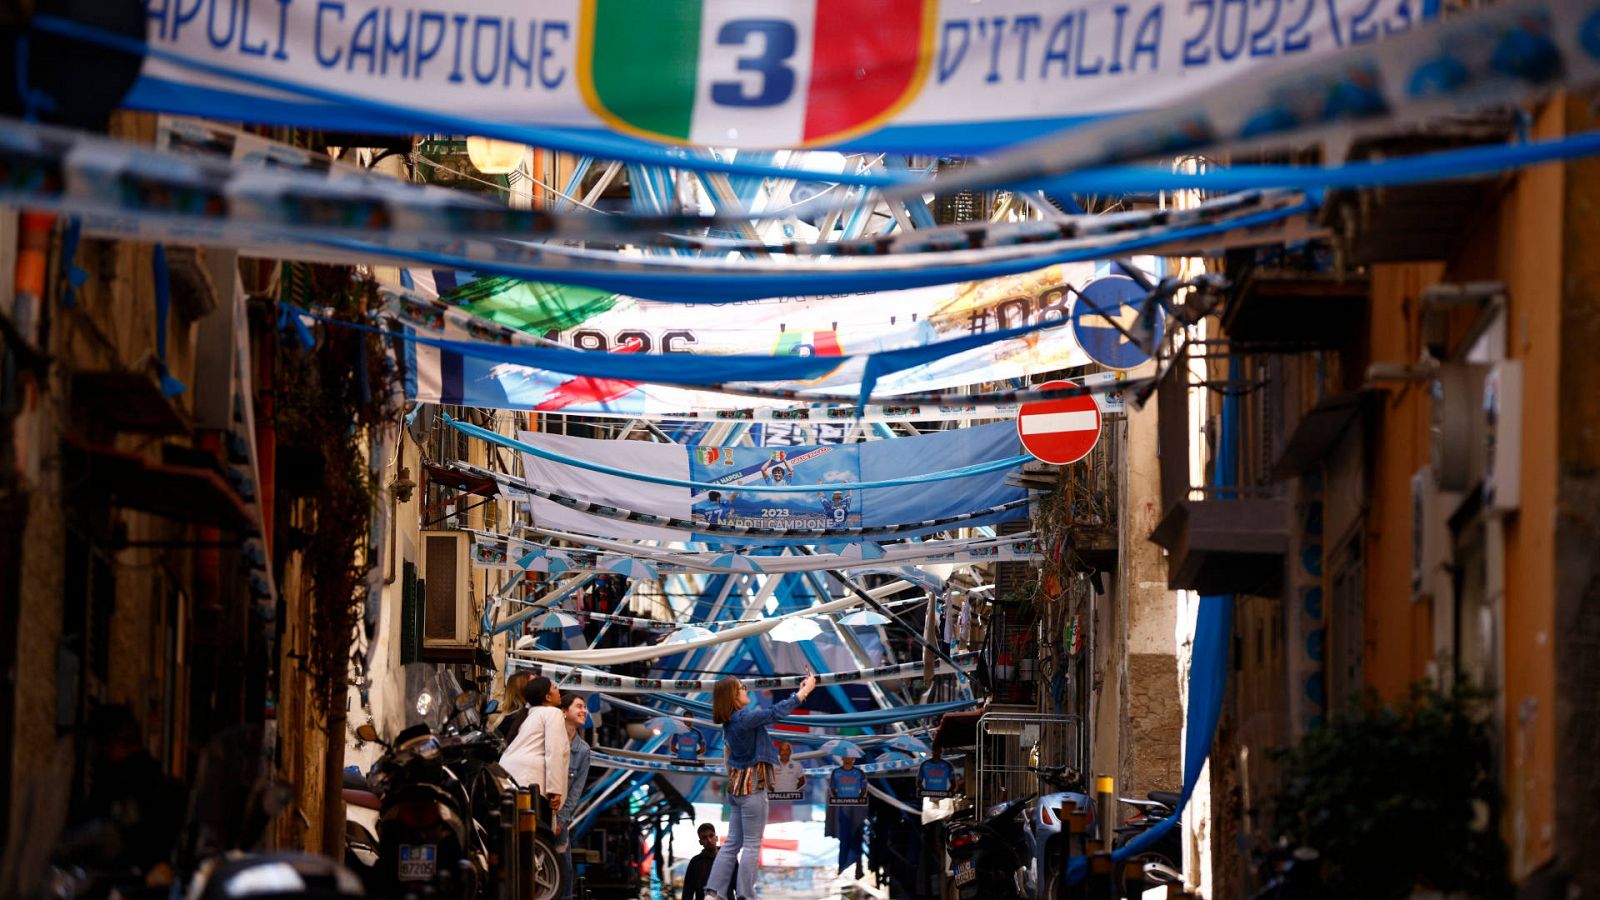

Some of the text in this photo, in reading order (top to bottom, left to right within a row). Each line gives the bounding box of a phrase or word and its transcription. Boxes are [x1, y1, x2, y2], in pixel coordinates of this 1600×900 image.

[313, 1, 570, 89] CAMPIONE
[937, 4, 1164, 84] D'ITALIA
[711, 18, 798, 107] 3
[761, 509, 790, 518] 2023
[833, 509, 845, 522] 9
[767, 518, 834, 529] CAMPIONE
[768, 792, 801, 800] SPALLETTI
